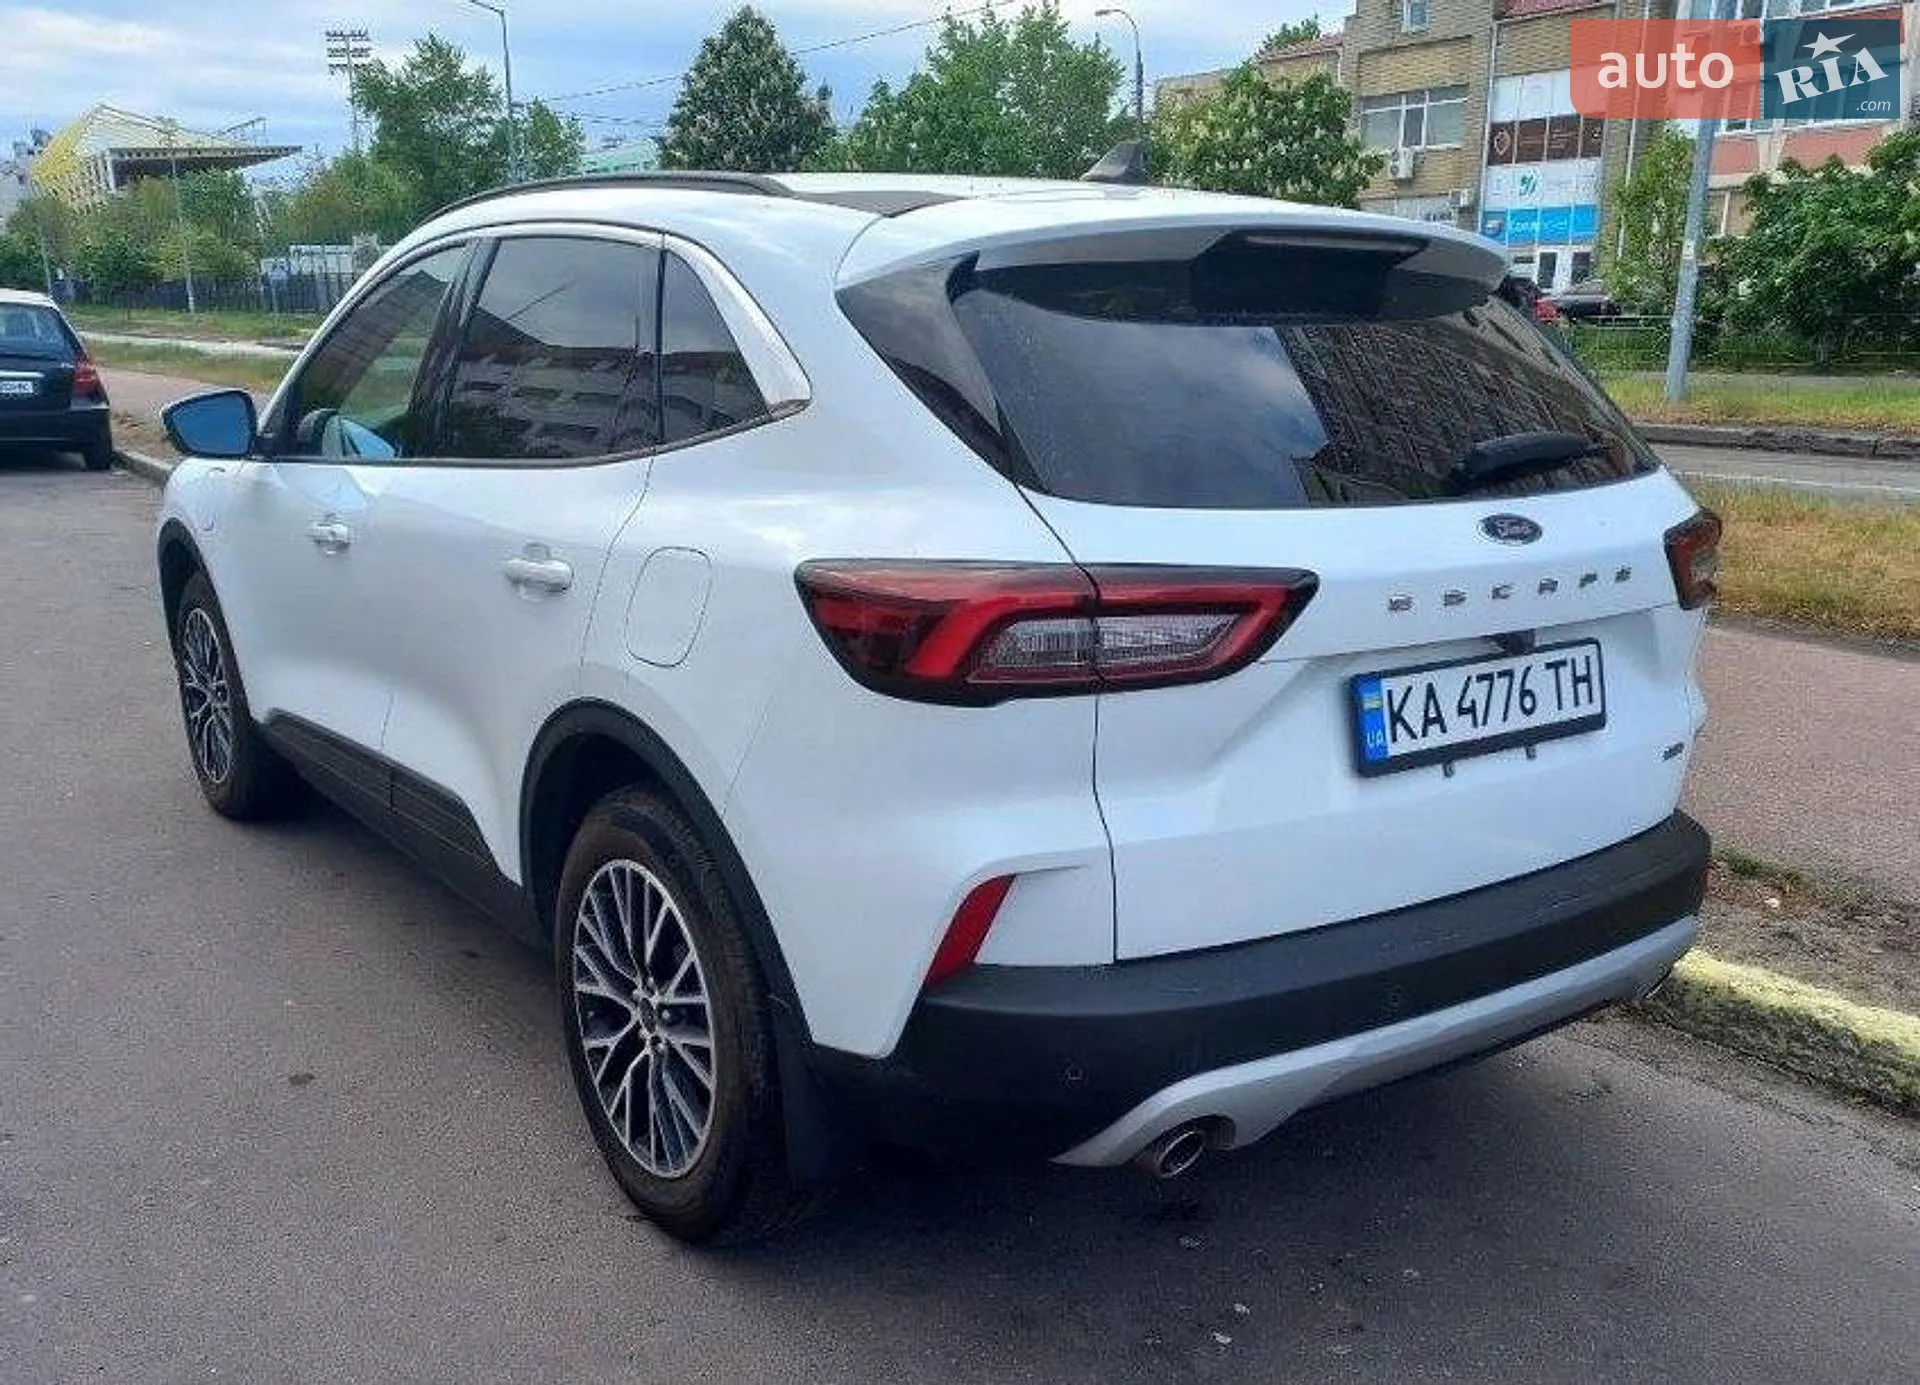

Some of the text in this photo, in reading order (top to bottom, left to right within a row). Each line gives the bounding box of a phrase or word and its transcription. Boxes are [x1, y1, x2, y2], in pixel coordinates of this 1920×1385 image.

[1386, 655, 1594, 743] KA 4776 TH
[1366, 730, 1386, 748] UA
